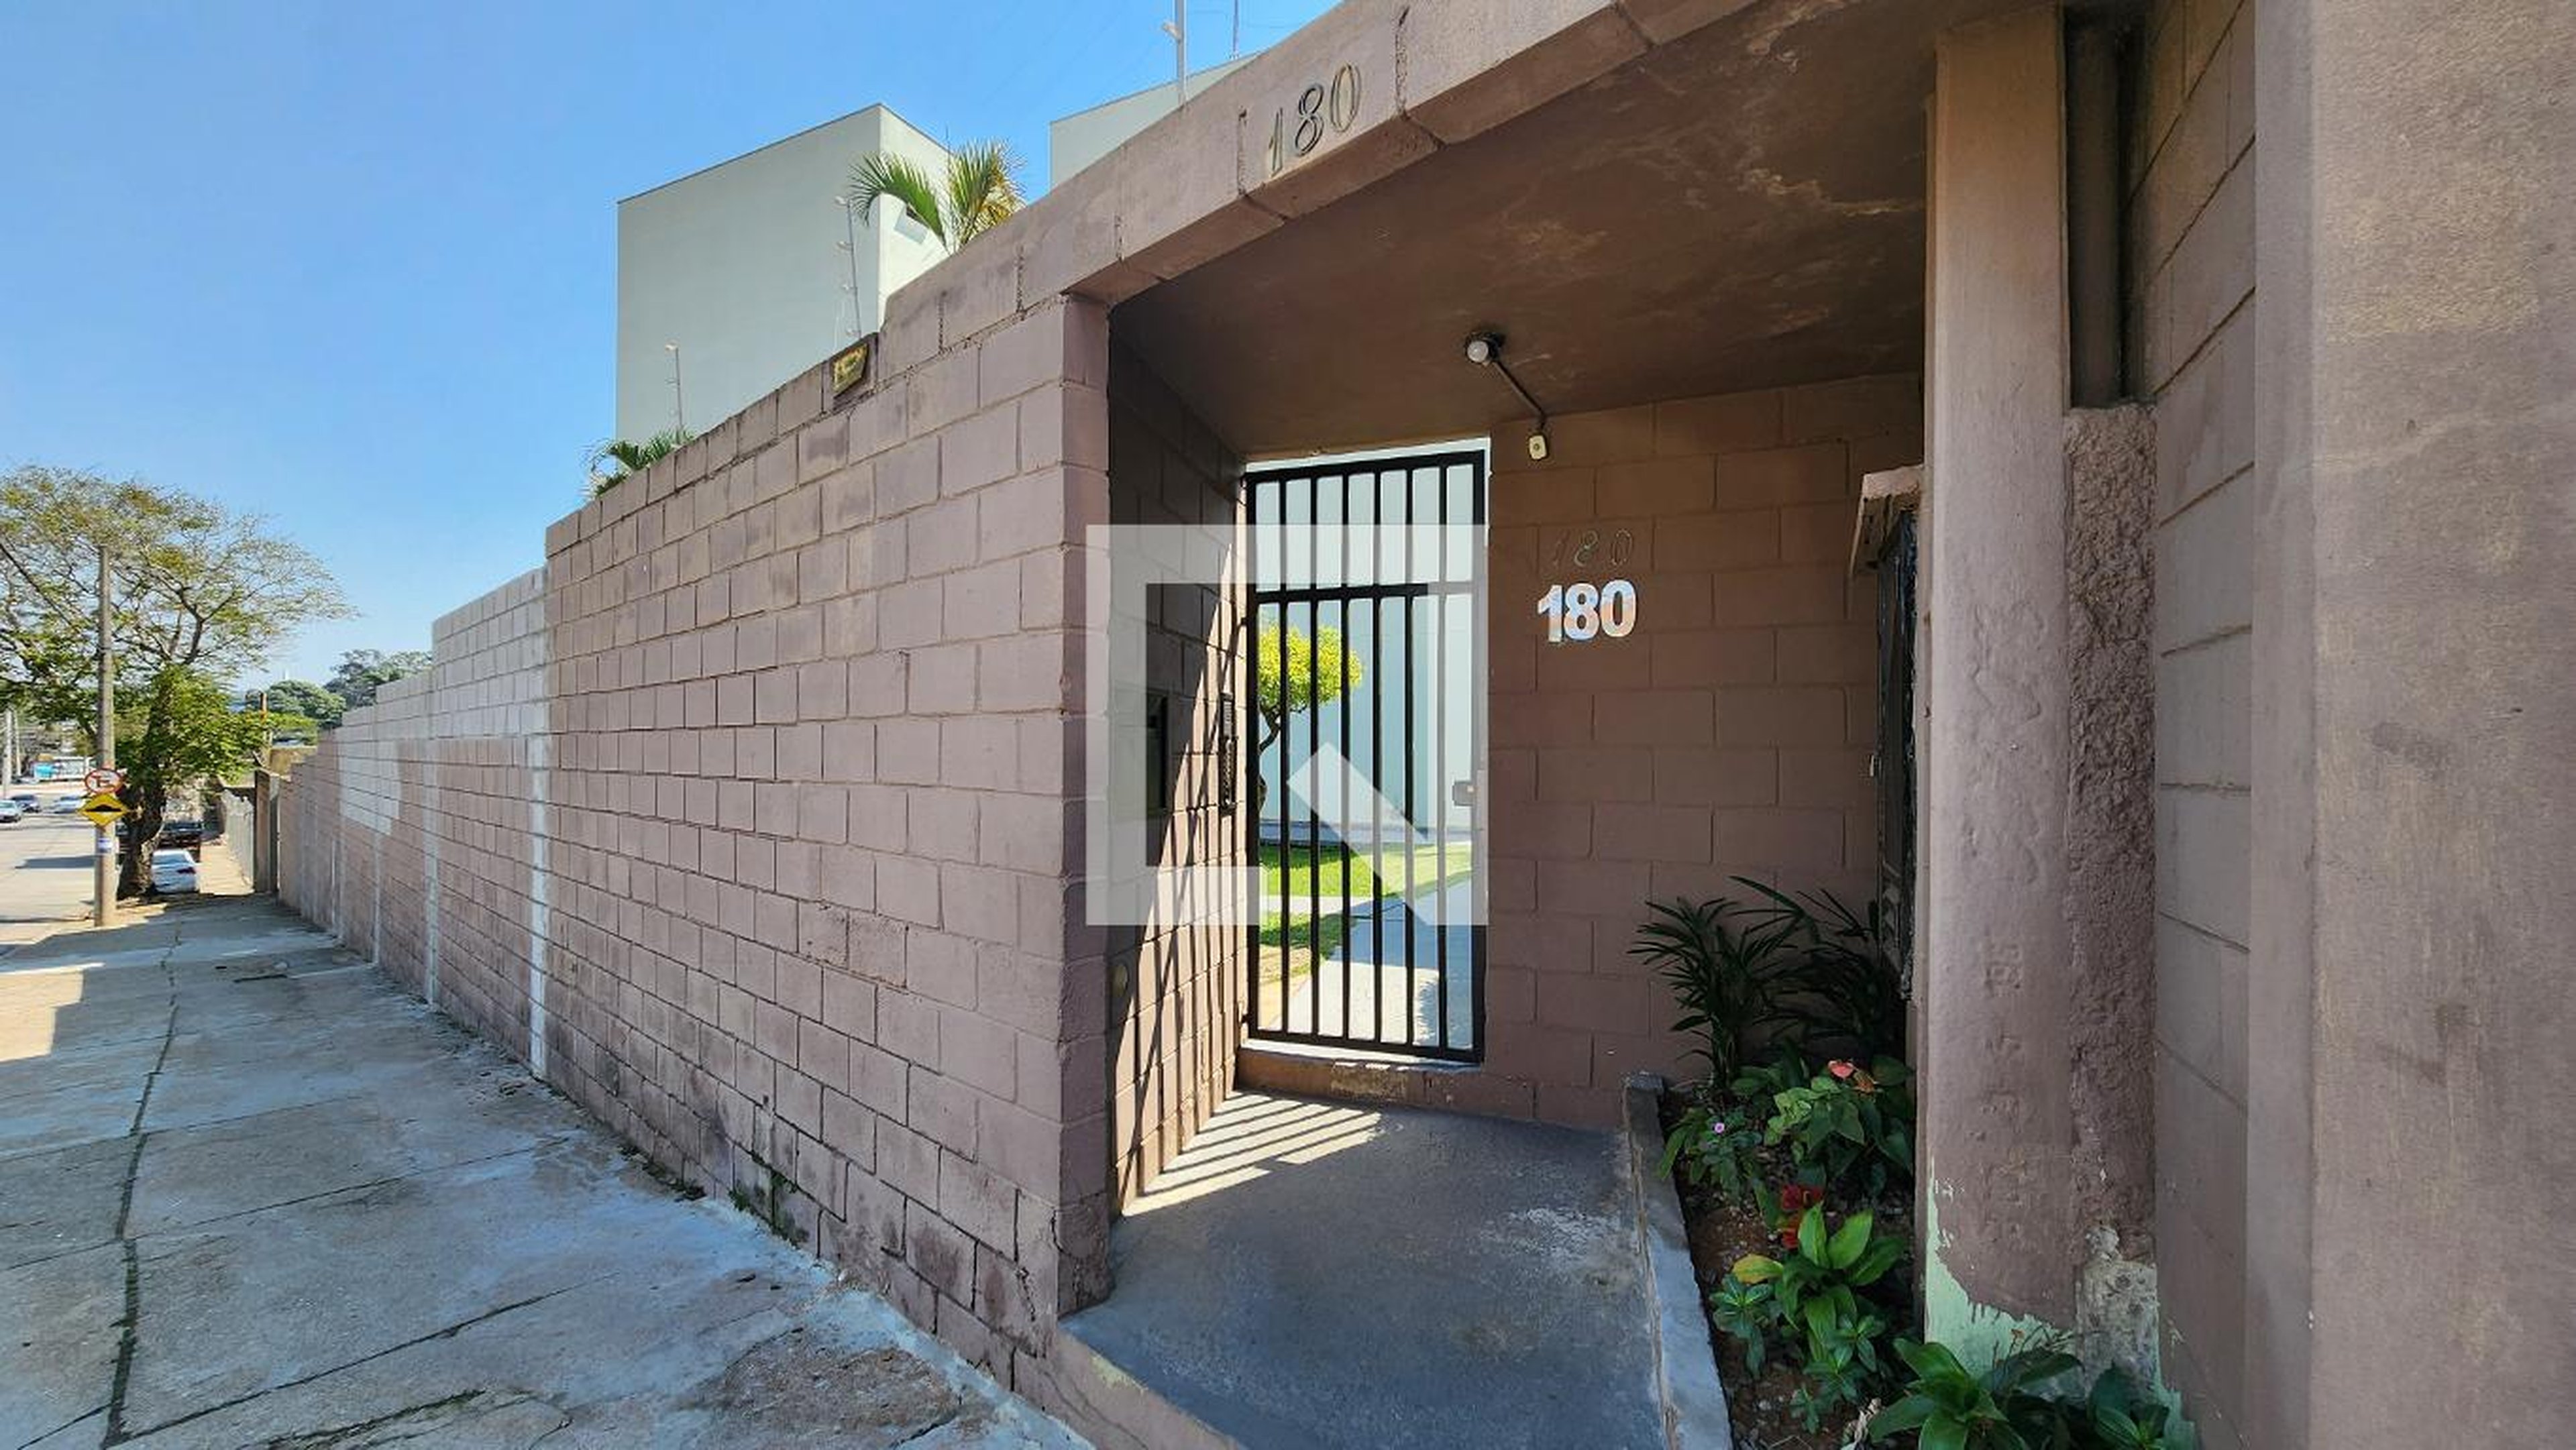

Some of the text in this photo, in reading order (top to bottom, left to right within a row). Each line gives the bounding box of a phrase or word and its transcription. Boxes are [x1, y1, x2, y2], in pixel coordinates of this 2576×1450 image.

[1269, 64, 1362, 176] 180
[1552, 528, 1633, 567] 180
[1537, 579, 1637, 643] 180
